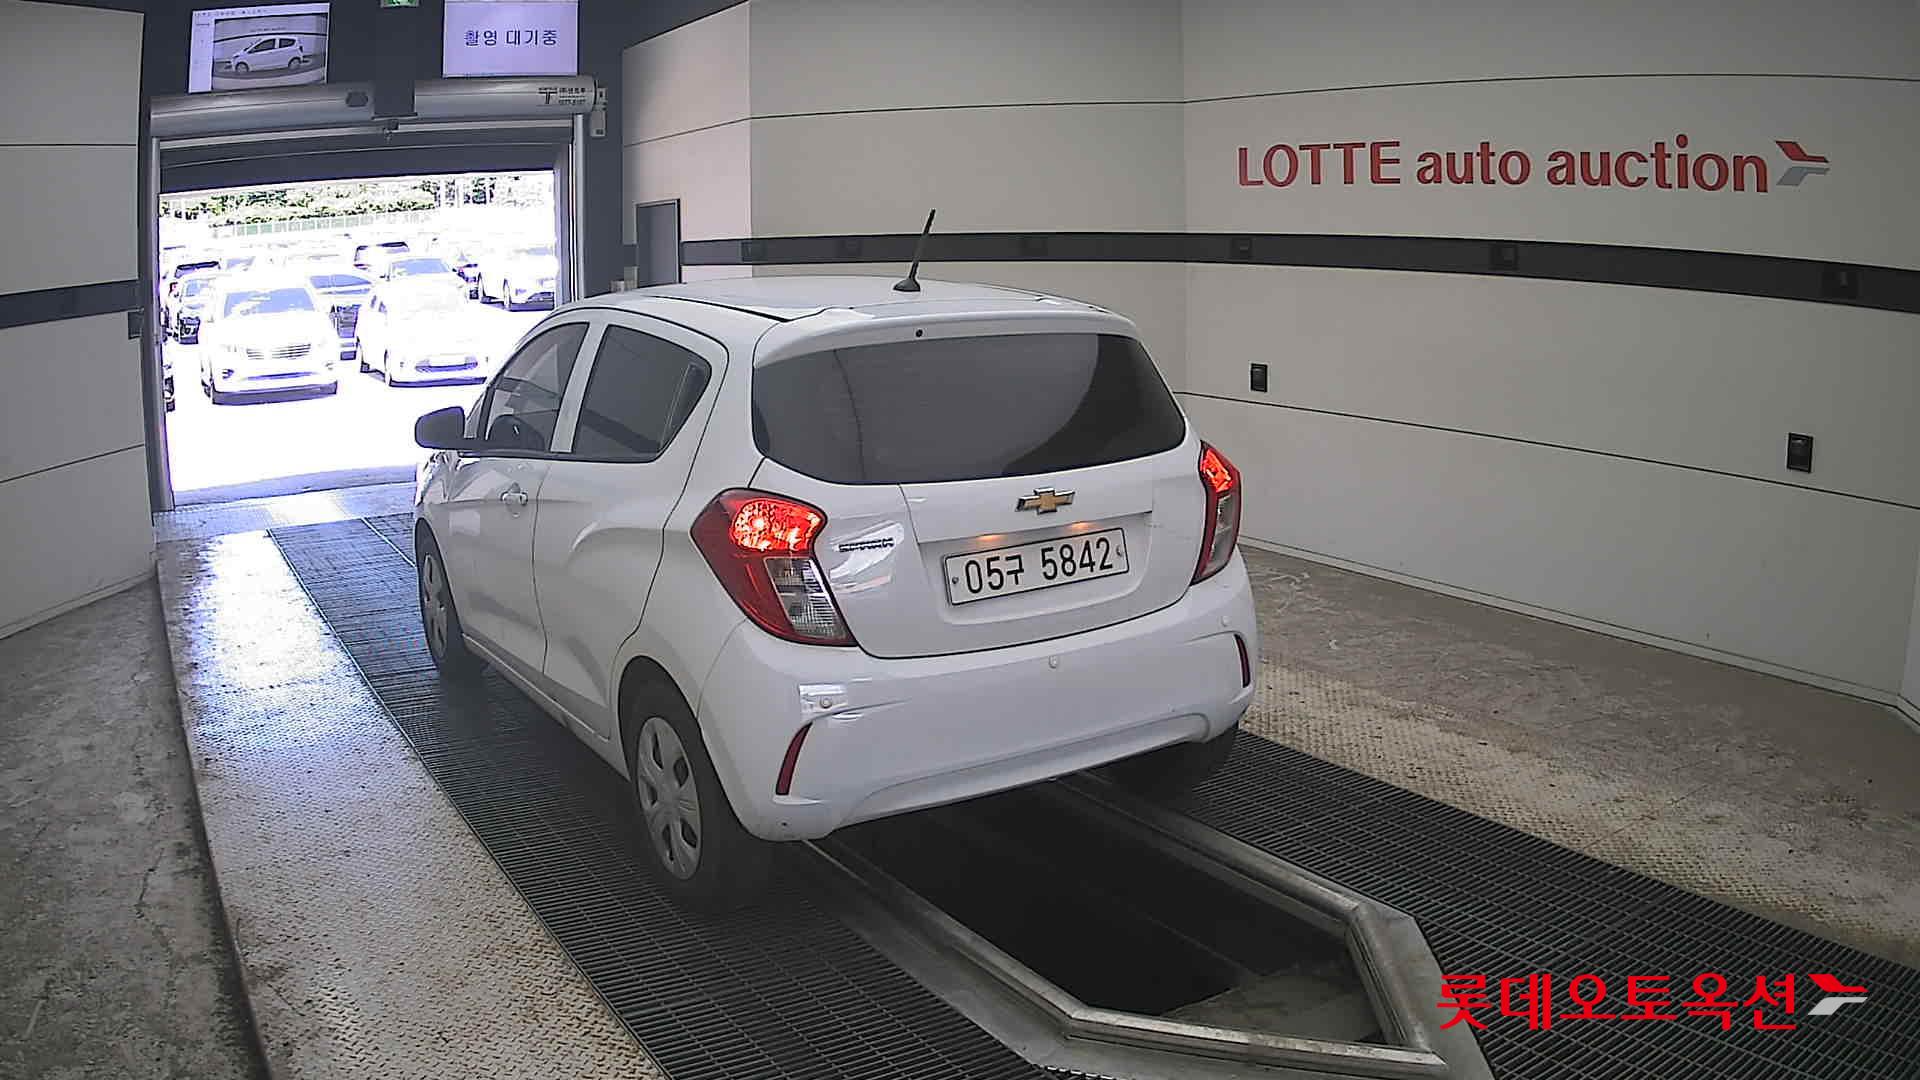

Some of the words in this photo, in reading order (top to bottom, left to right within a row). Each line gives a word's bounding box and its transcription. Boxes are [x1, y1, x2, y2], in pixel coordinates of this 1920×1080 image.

[464, 30, 497, 47] 촬영
[506, 30, 557, 46] 대기중
[1238, 141, 1400, 187] LOTTE
[1416, 140, 1531, 186] auto
[1547, 133, 1768, 193] auction
[964, 554, 1025, 595] 05구
[1040, 536, 1114, 581] 5842
